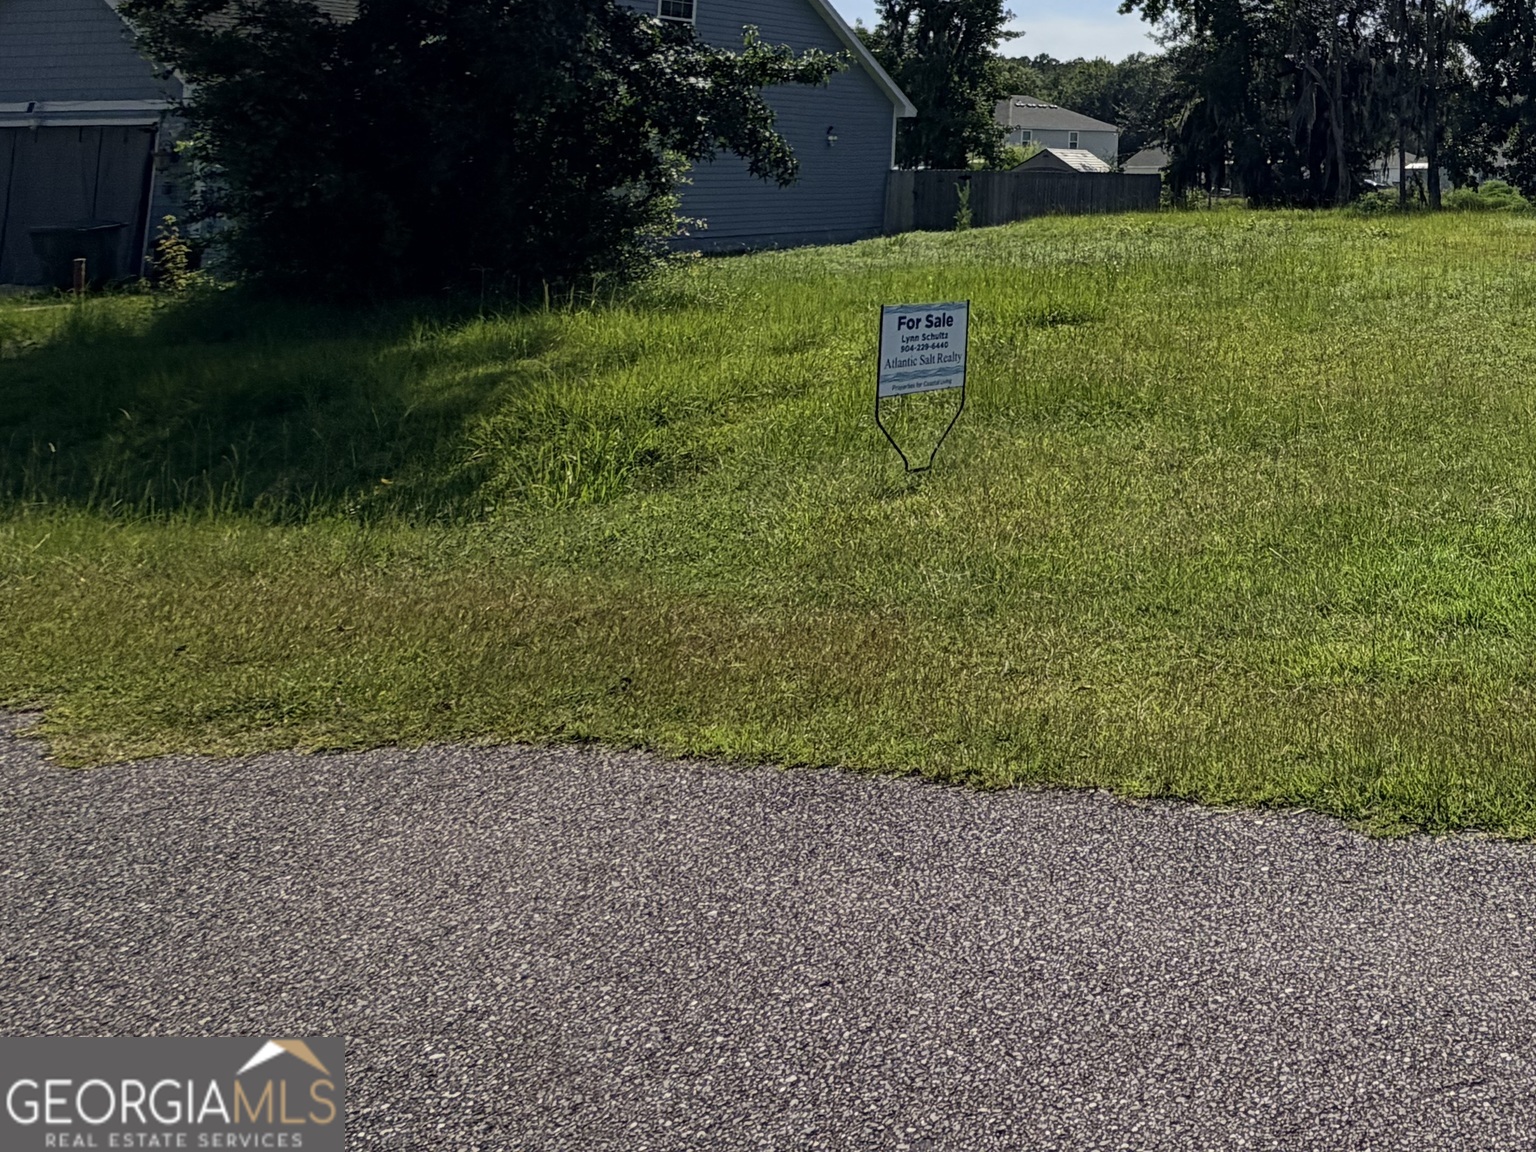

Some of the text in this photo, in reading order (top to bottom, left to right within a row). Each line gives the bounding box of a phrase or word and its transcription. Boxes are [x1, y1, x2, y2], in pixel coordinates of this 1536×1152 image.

[897, 312, 954, 331] For Sale
[901, 331, 949, 344] Lynn Schultz
[884, 351, 962, 370] Atlantic Salt Realty
